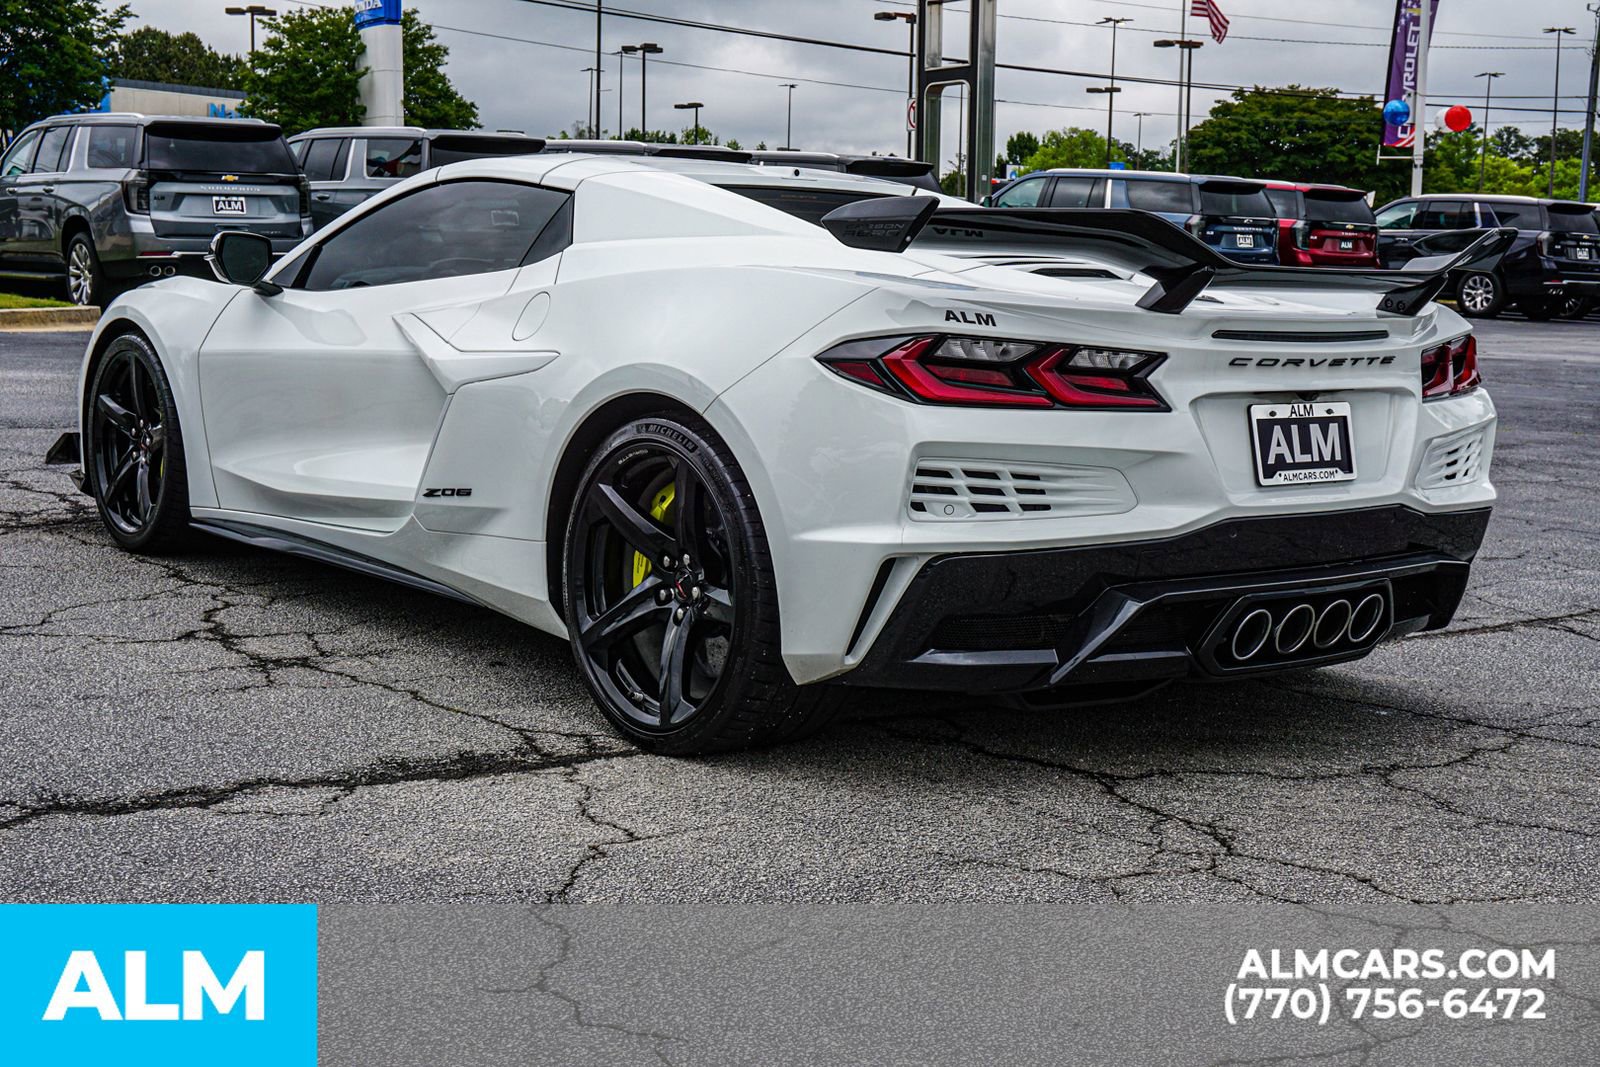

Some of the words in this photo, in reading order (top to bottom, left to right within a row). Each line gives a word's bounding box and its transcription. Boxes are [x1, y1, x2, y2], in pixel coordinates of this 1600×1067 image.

[217, 201, 241, 211] ALM
[1341, 241, 1353, 249] ALM
[944, 309, 997, 327] ALM
[1228, 355, 1396, 368] CORVETTE
[1289, 404, 1315, 418] ALM
[648, 423, 697, 450] MICHELIN
[1267, 422, 1342, 465] ALM
[1283, 470, 1336, 482] ALMCARS.COM
[422, 487, 473, 498] Z06
